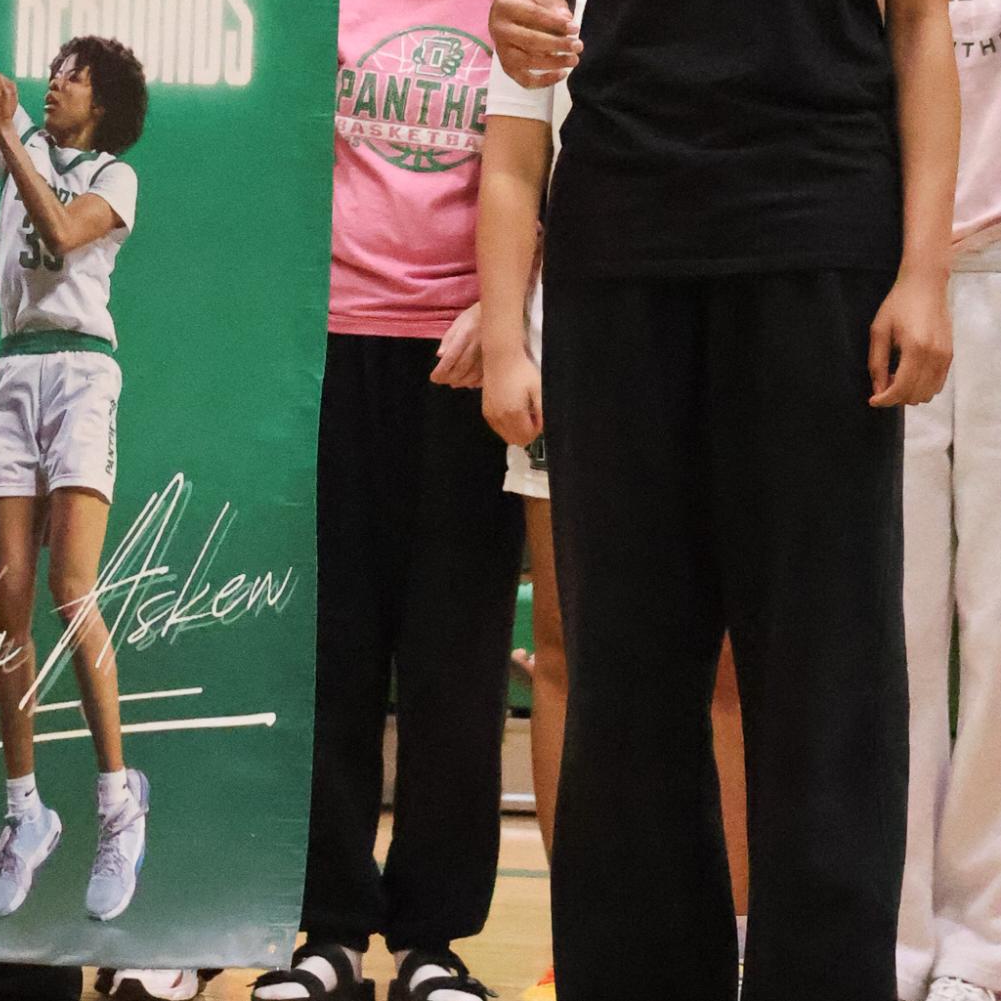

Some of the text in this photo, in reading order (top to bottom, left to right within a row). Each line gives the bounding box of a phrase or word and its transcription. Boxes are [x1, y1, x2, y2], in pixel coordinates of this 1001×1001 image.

[336, 68, 488, 133] PANTHE
[336, 118, 477, 150] BASKETBA
[18, 472, 297, 712] Askew
